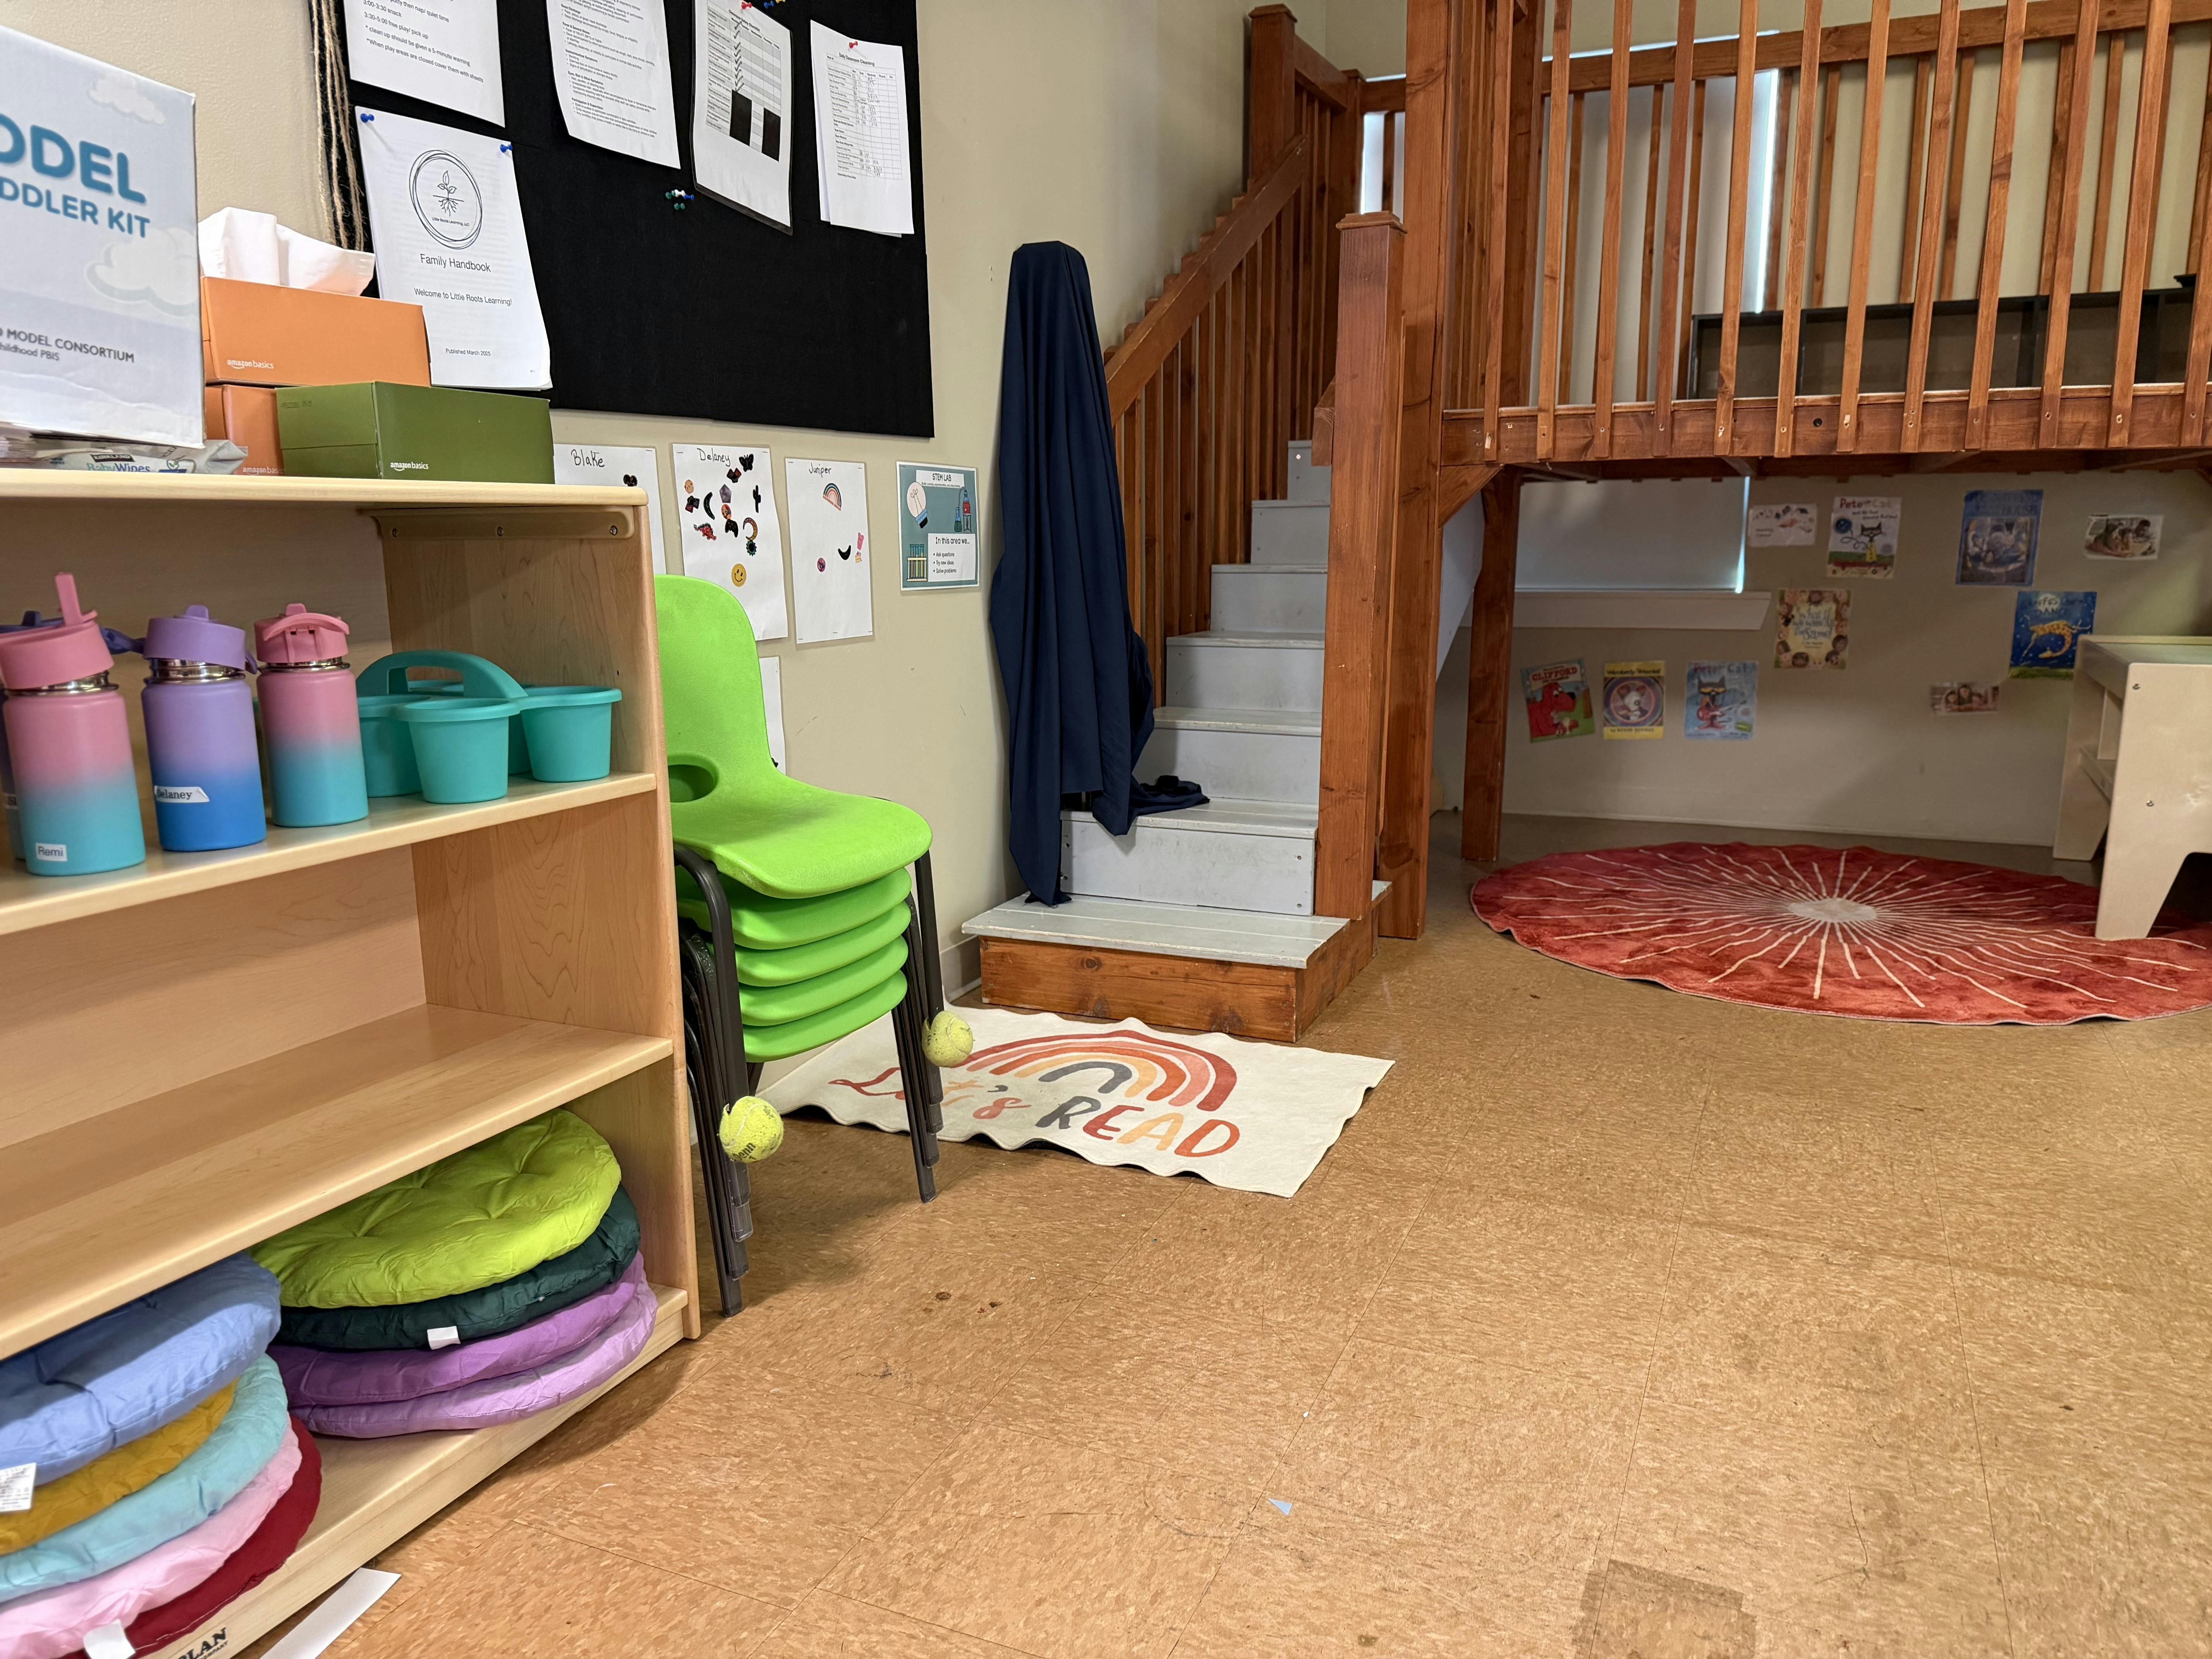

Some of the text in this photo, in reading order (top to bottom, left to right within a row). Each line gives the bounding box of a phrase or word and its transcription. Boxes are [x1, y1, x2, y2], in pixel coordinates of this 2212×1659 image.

[364, 12, 387, 24] 3:30-5:00
[369, 27, 383, 35] clean
[392, 34, 407, 44] should
[453, 56, 470, 67] warning
[385, 45, 395, 53] play
[419, 56, 433, 65] closed
[448, 66, 459, 74] them
[108, 207, 150, 238] KIT
[421, 254, 491, 272] Family Handbook
[414, 288, 441, 298] Welcome
[466, 294, 483, 303] Roots
[485, 296, 512, 306] Learning!
[7, 329, 134, 363] MODEL CONSORTIUM
[40, 350, 60, 361] PBIS
[571, 449, 605, 467] Blake
[697, 448, 730, 467] Delaney
[809, 462, 831, 478] Juniper
[933, 473, 943, 481] STEM
[157, 788, 192, 800] Delaney
[38, 846, 63, 857] Remi
[1035, 1096, 1240, 1157] READ
